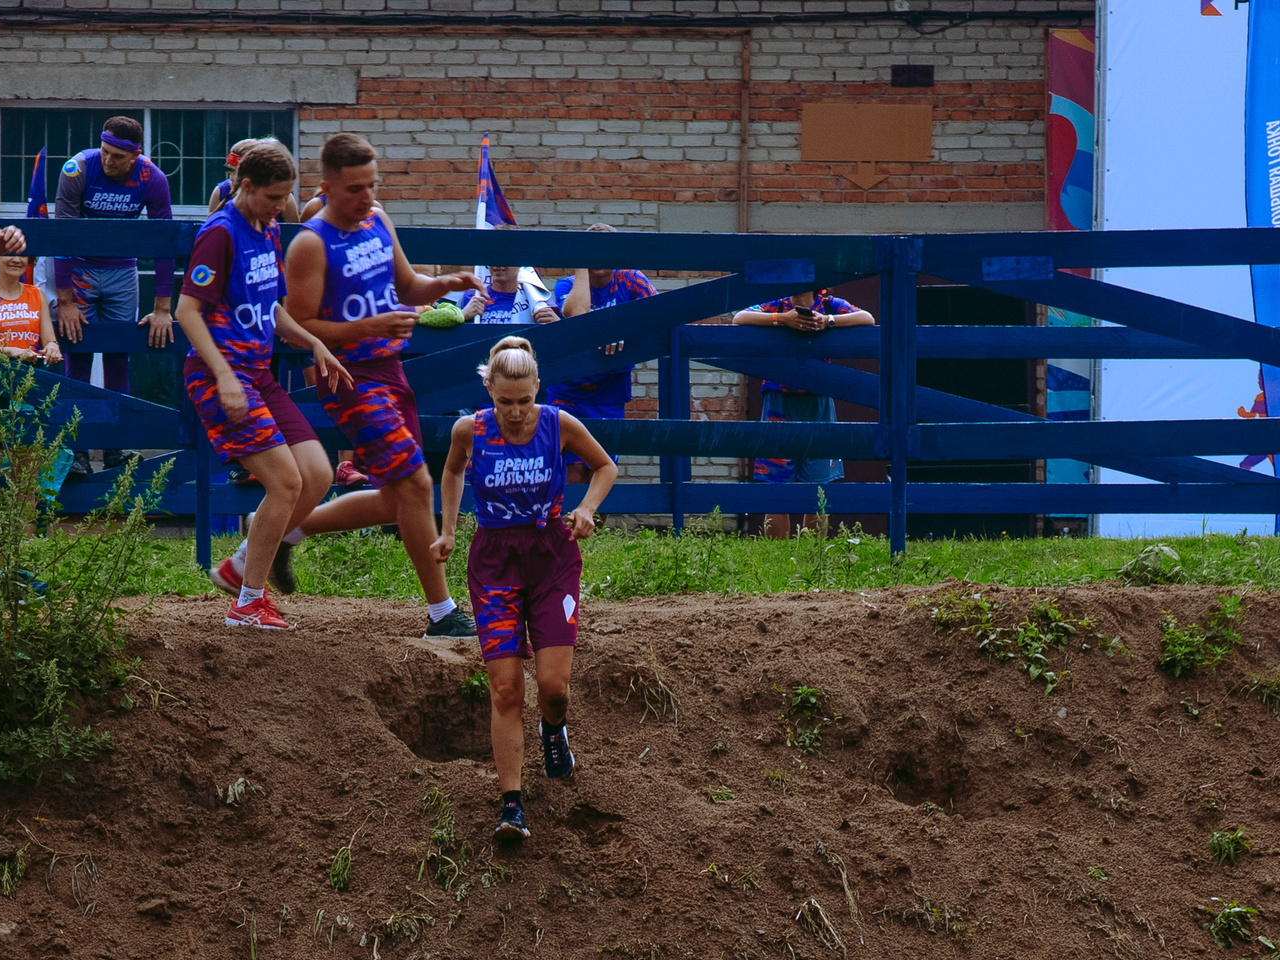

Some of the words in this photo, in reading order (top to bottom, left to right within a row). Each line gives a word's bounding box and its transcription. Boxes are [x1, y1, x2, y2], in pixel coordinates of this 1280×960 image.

[92, 192, 132, 203] ВРЕМЯ
[83, 200, 141, 212] СИЛЬНЫХ
[493, 456, 544, 474] ВРЕМЯ
